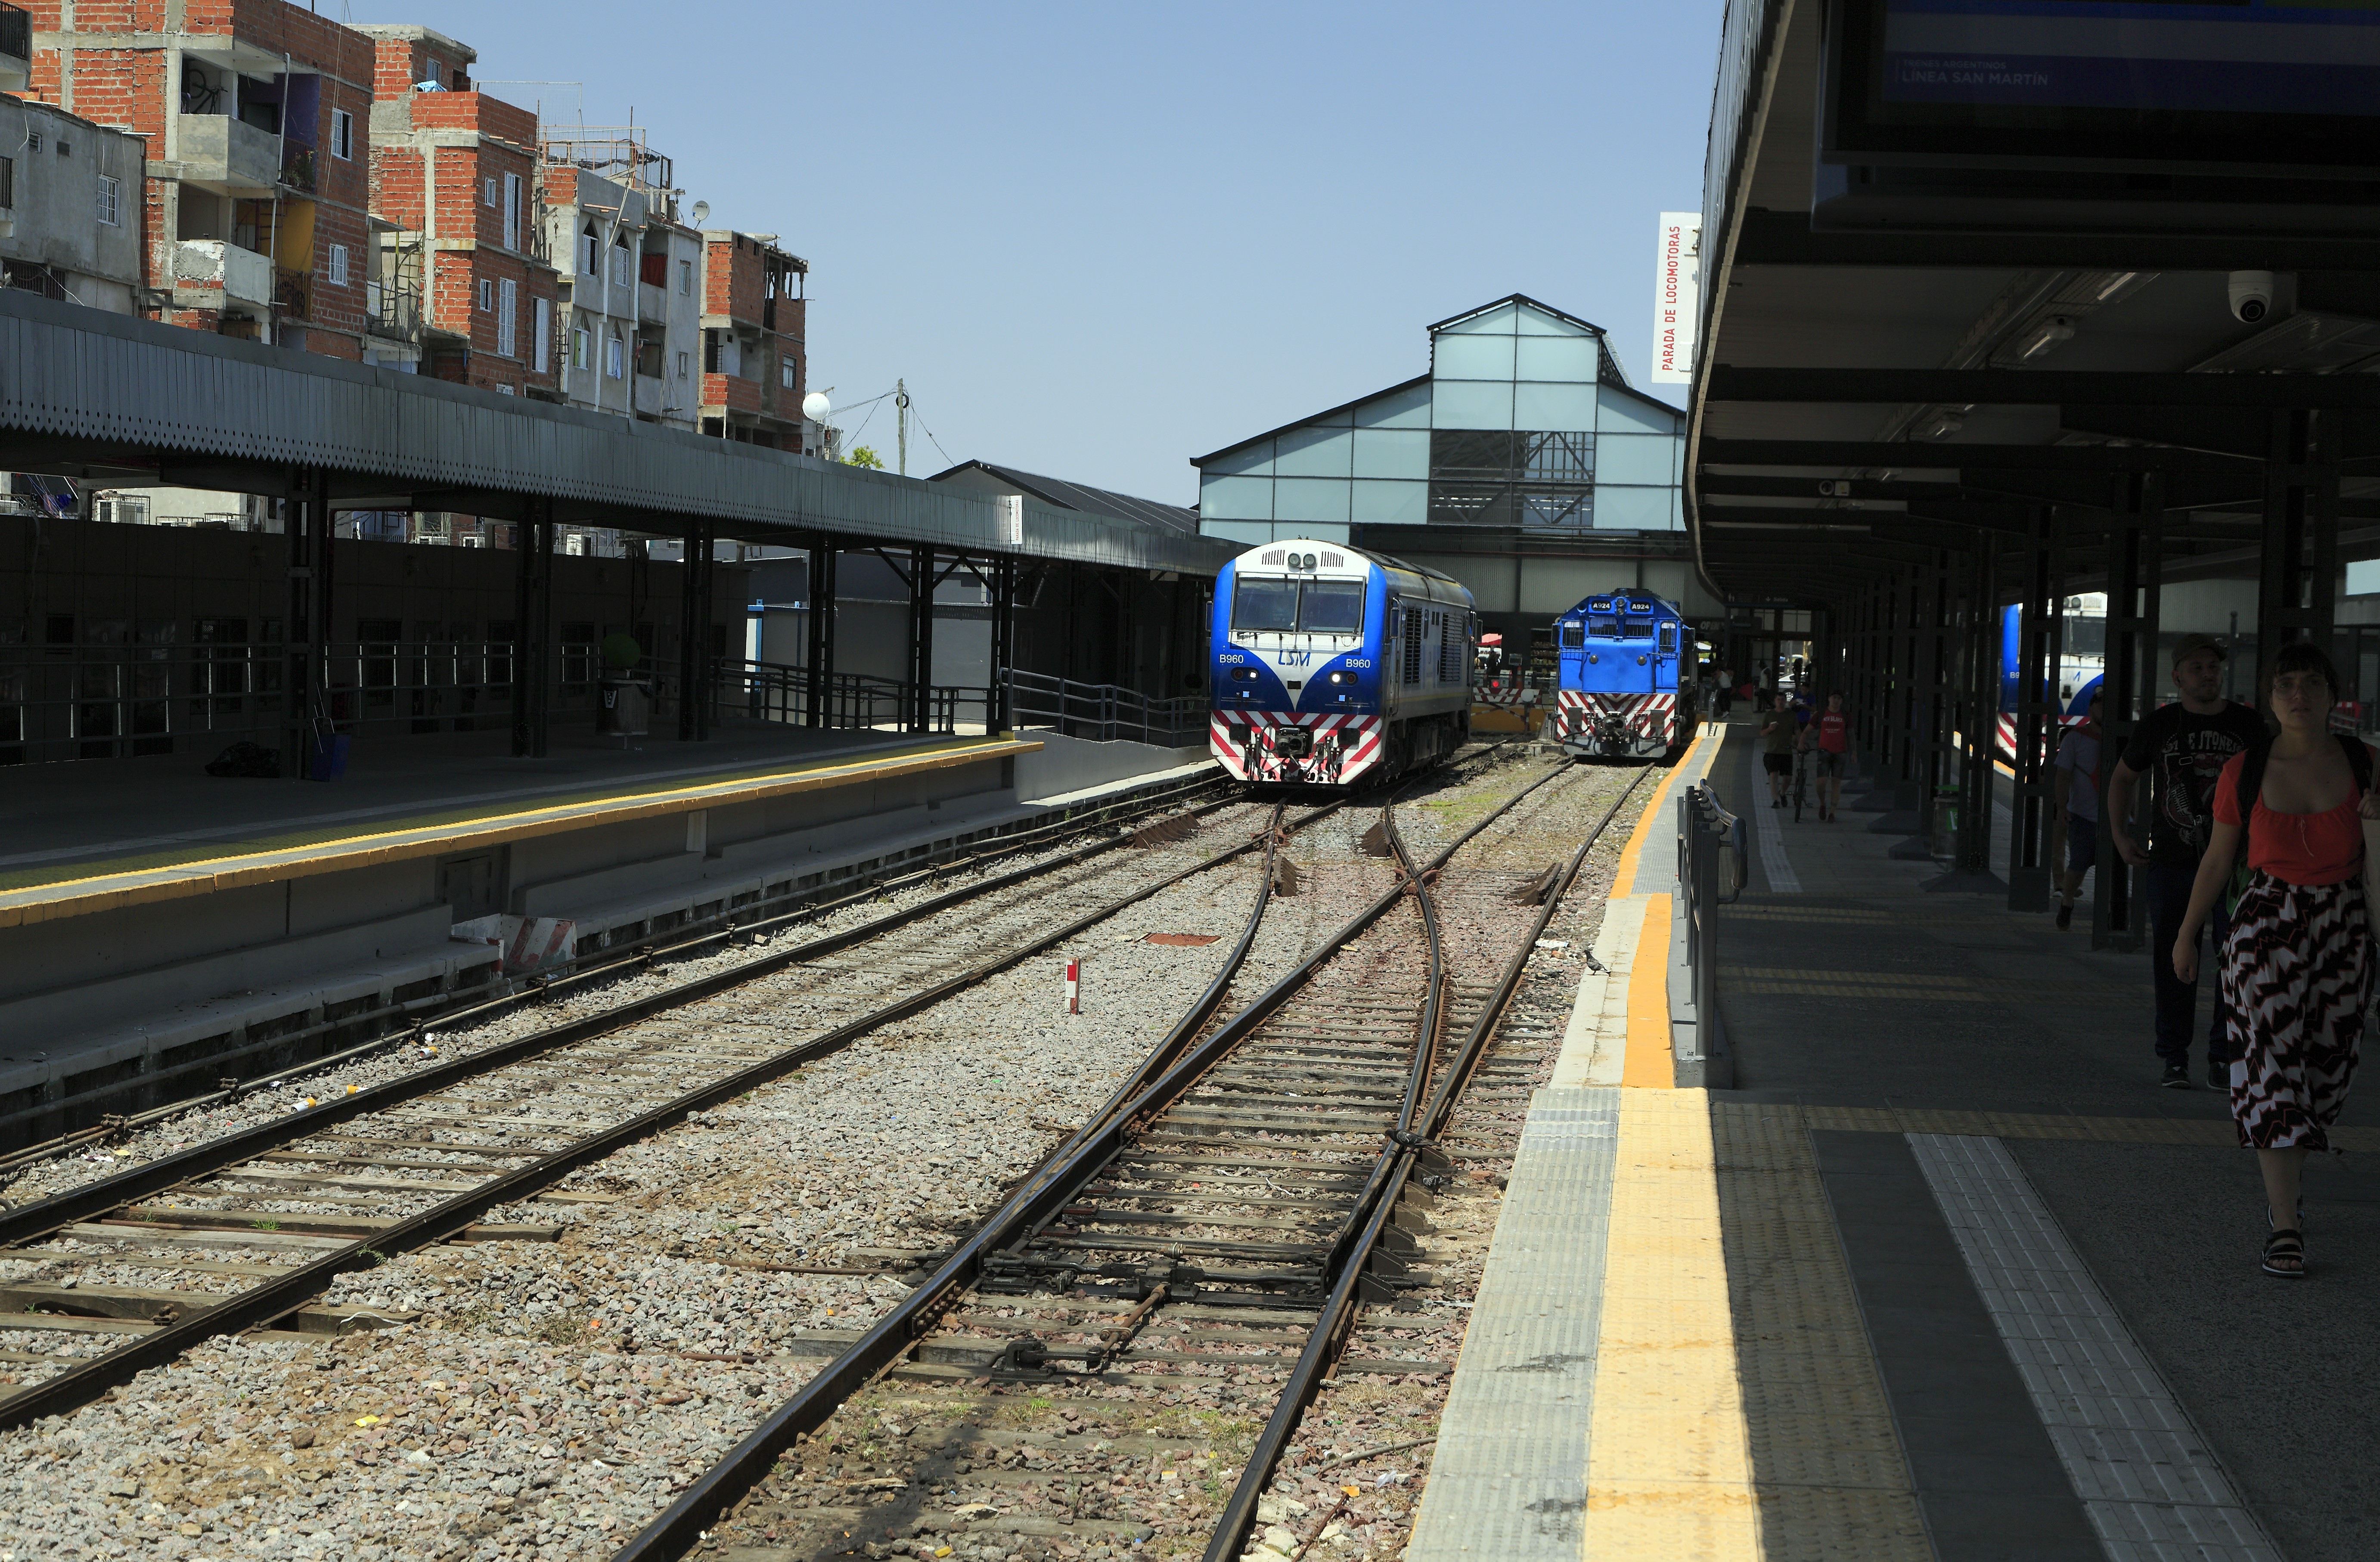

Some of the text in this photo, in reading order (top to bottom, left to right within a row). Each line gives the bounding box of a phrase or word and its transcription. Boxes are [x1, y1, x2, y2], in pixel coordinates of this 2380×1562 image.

[1902, 59, 2007, 70] TRENES ARGENTINOS
[1901, 69, 2048, 87] LÍNEA SAN MARTÍN
[1662, 226, 1680, 371] PARADA DE LOCOMOTORAS
[1219, 654, 1244, 664] B960
[1278, 650, 1311, 666] LSM
[1346, 658, 1371, 669] B960
